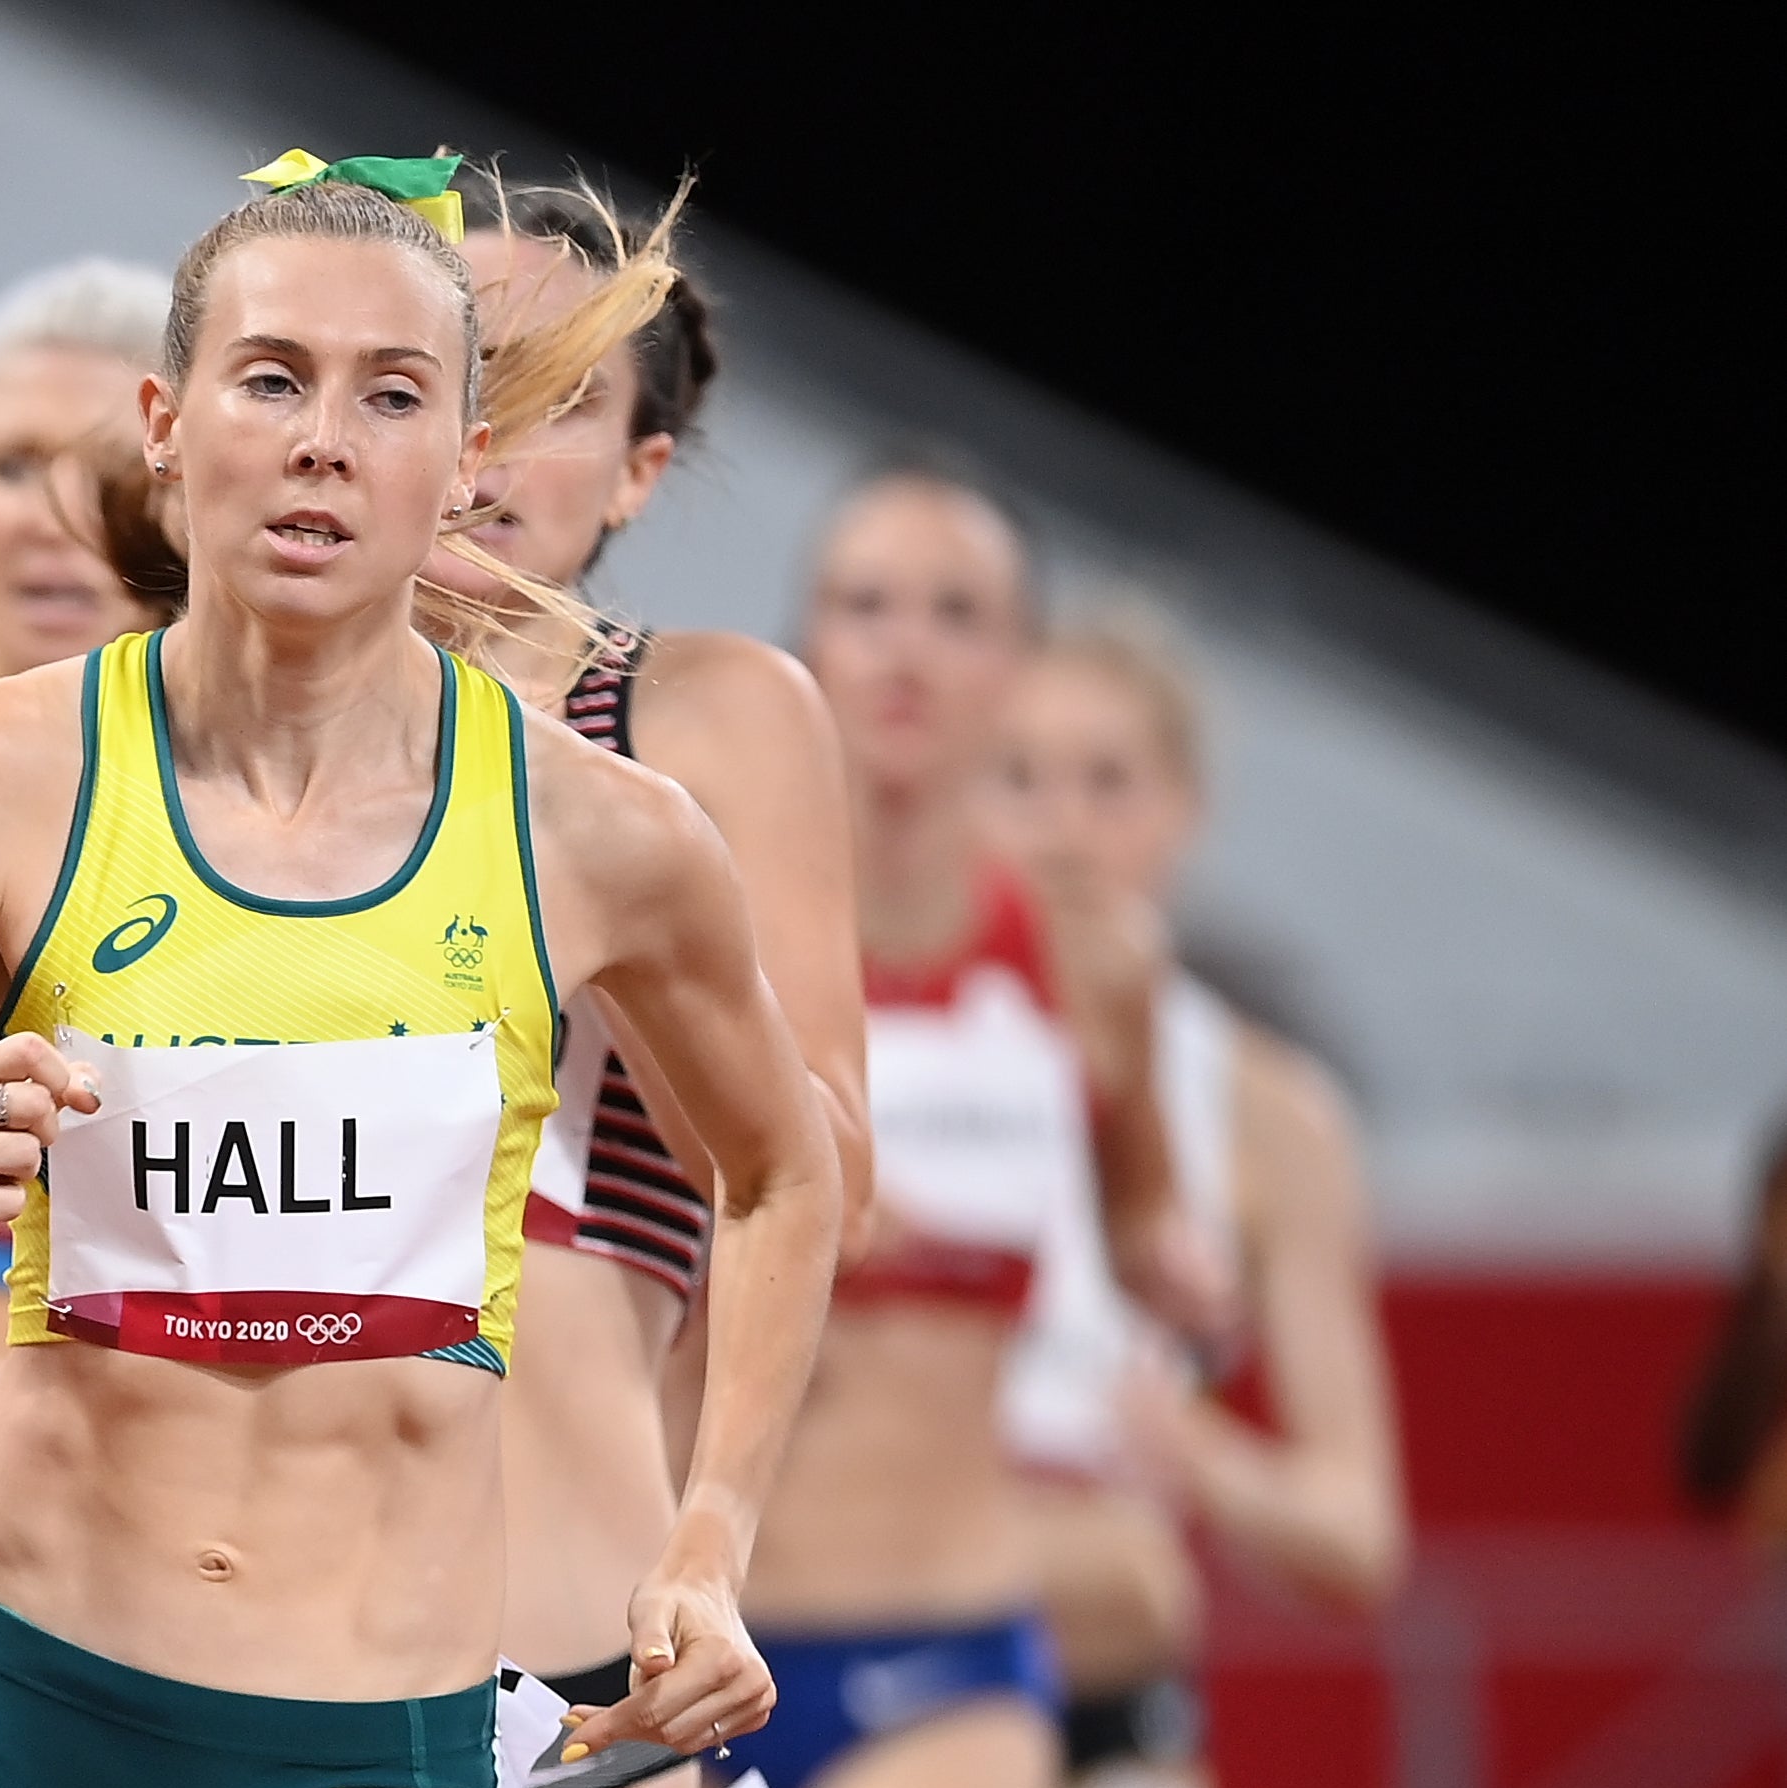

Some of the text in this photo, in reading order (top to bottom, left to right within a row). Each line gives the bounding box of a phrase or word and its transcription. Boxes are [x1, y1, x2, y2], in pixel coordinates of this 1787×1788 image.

[130, 1117, 392, 1214] HALL
[164, 1314, 289, 1341] TOKYO 2020
